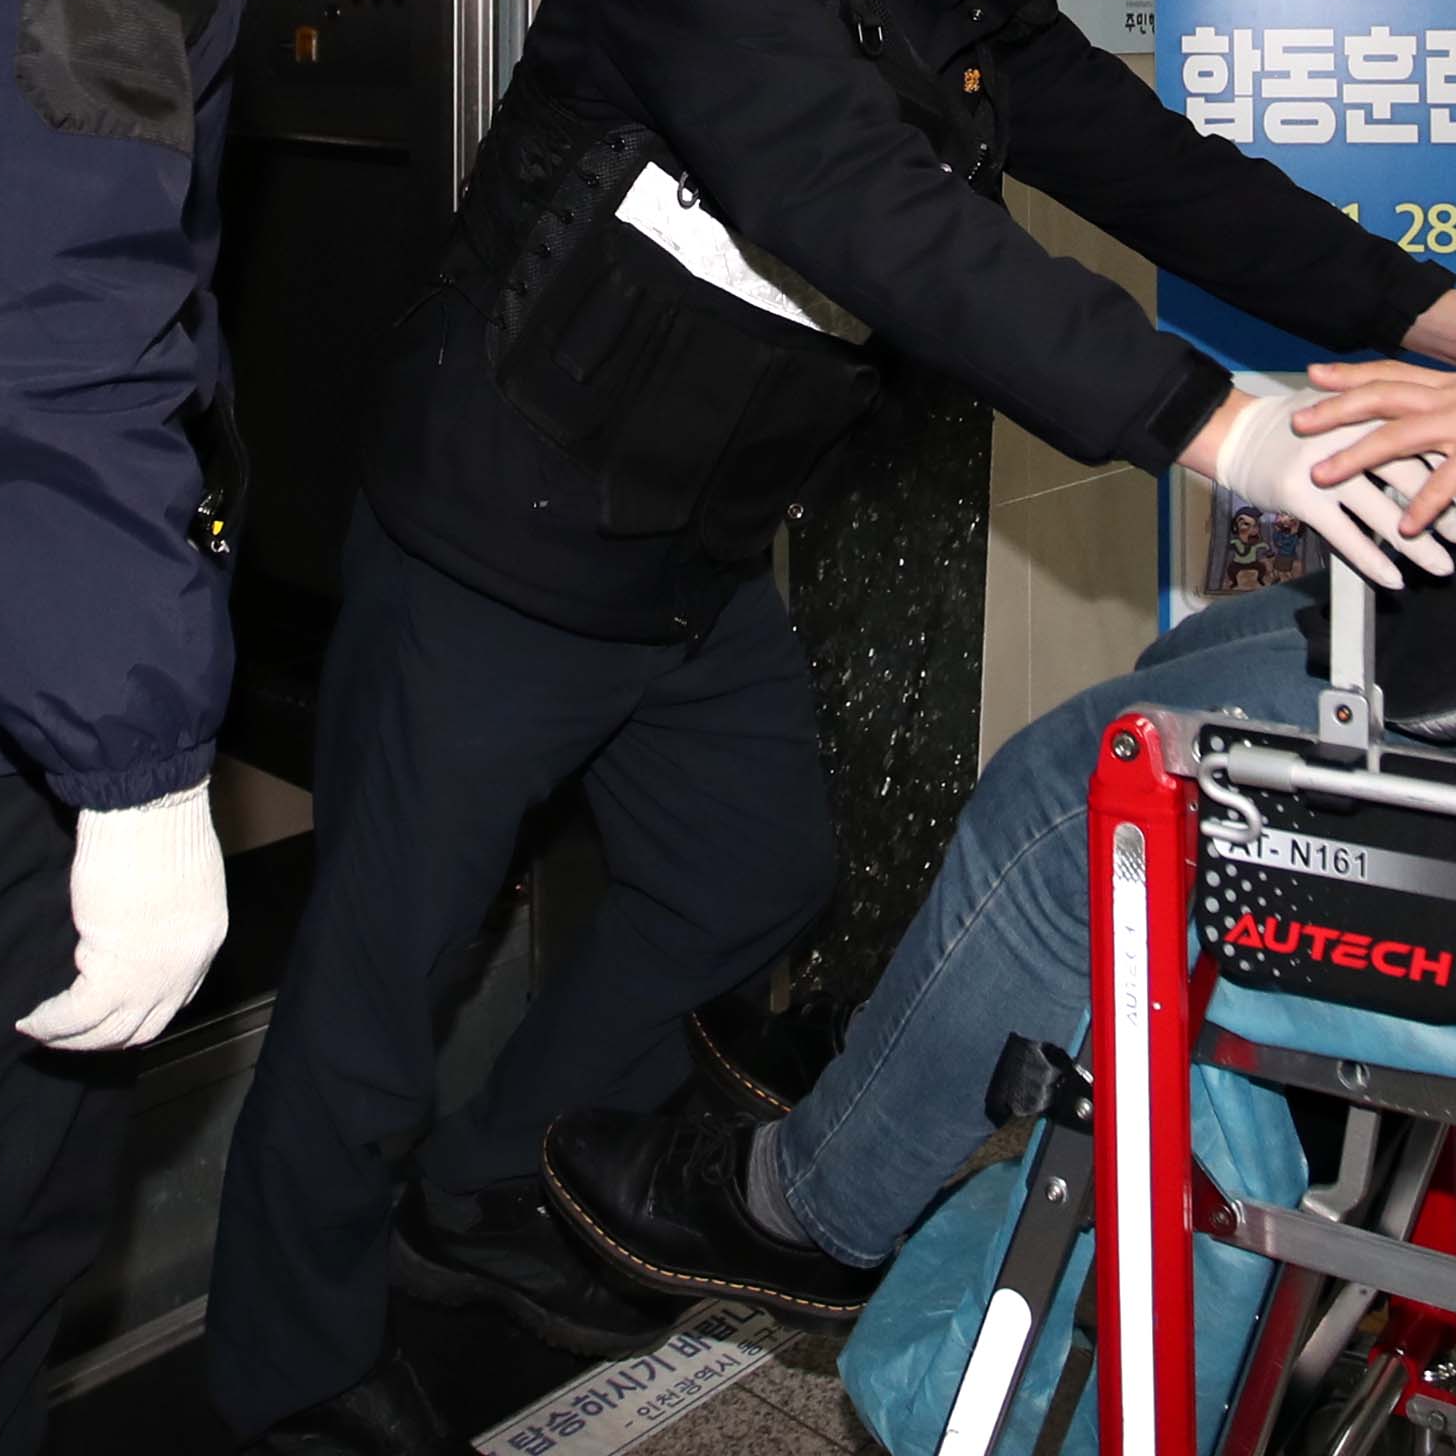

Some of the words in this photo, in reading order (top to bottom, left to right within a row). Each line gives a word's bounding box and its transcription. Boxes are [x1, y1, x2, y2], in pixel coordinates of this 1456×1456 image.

[1291, 839, 1368, 878] N161
[1223, 912, 1452, 987] AUTECH
[508, 1355, 677, 1456] 탑승하시기
[636, 1353, 741, 1421] 인천광역시
